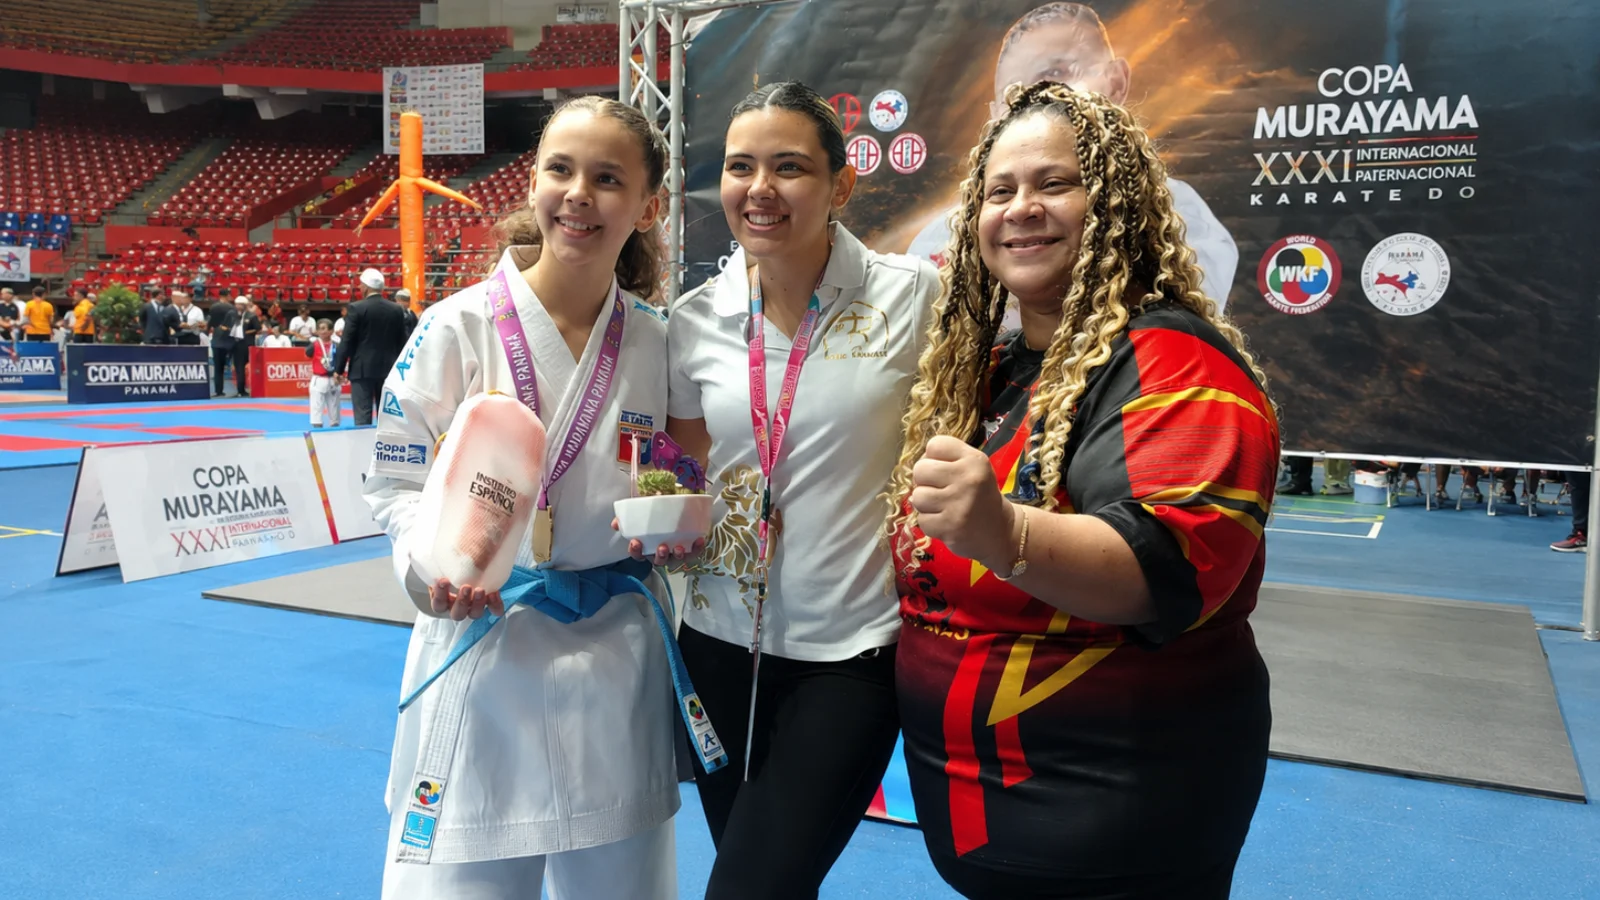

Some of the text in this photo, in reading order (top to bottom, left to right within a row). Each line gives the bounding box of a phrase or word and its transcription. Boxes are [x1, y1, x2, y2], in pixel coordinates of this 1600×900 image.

[1317, 63, 1413, 98] COPA
[1253, 94, 1479, 139] MURAYAMA
[1356, 144, 1477, 161] INTERNACIONAL
[1251, 149, 1353, 186] XXXI
[1250, 186, 1475, 206] KARATE DO
[1286, 235, 1316, 245] WORLD
[1279, 265, 1319, 283] WKF
[87, 363, 207, 383] COPA MURAYAMA
[267, 364, 297, 379] COPA
[375, 441, 406, 454] Copa
[193, 464, 249, 489] COPA
[163, 485, 287, 521] MURAYAMA
[170, 525, 230, 557] XXXI
